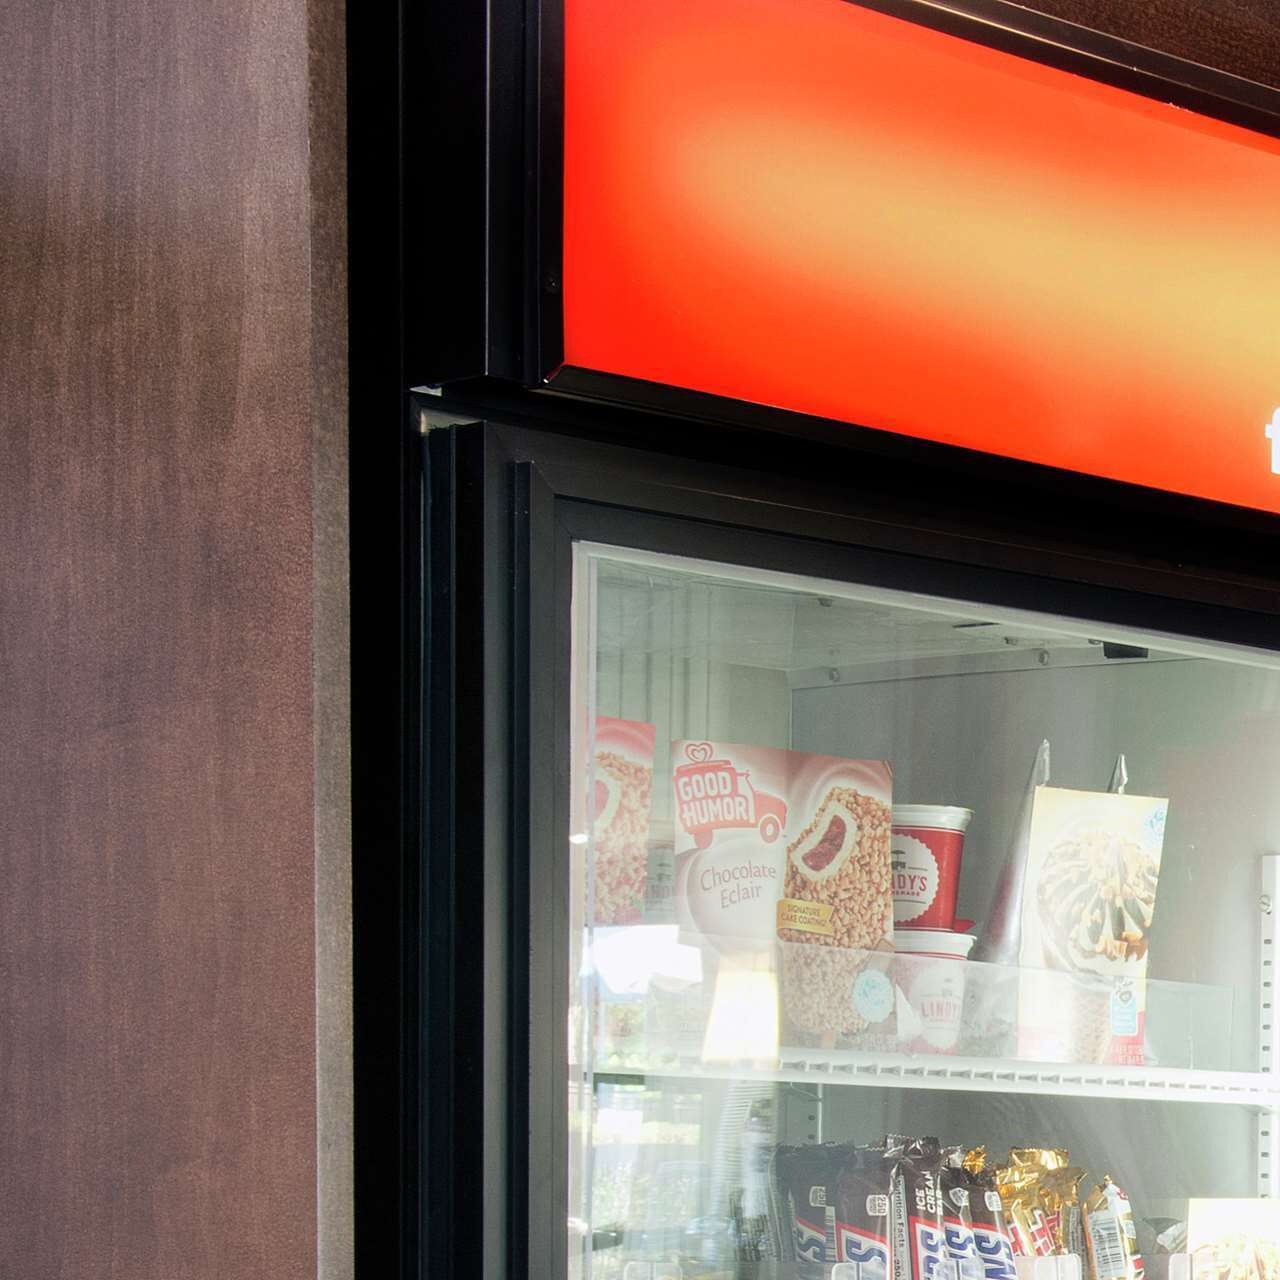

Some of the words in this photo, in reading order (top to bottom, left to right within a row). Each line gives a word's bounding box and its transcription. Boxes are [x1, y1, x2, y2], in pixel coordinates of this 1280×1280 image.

[678, 771, 733, 799] GOOD
[682, 797, 755, 827] HUMOR
[700, 861, 776, 893] Chocolate
[720, 884, 762, 909] Eclair
[915, 1187, 926, 1212] ICE
